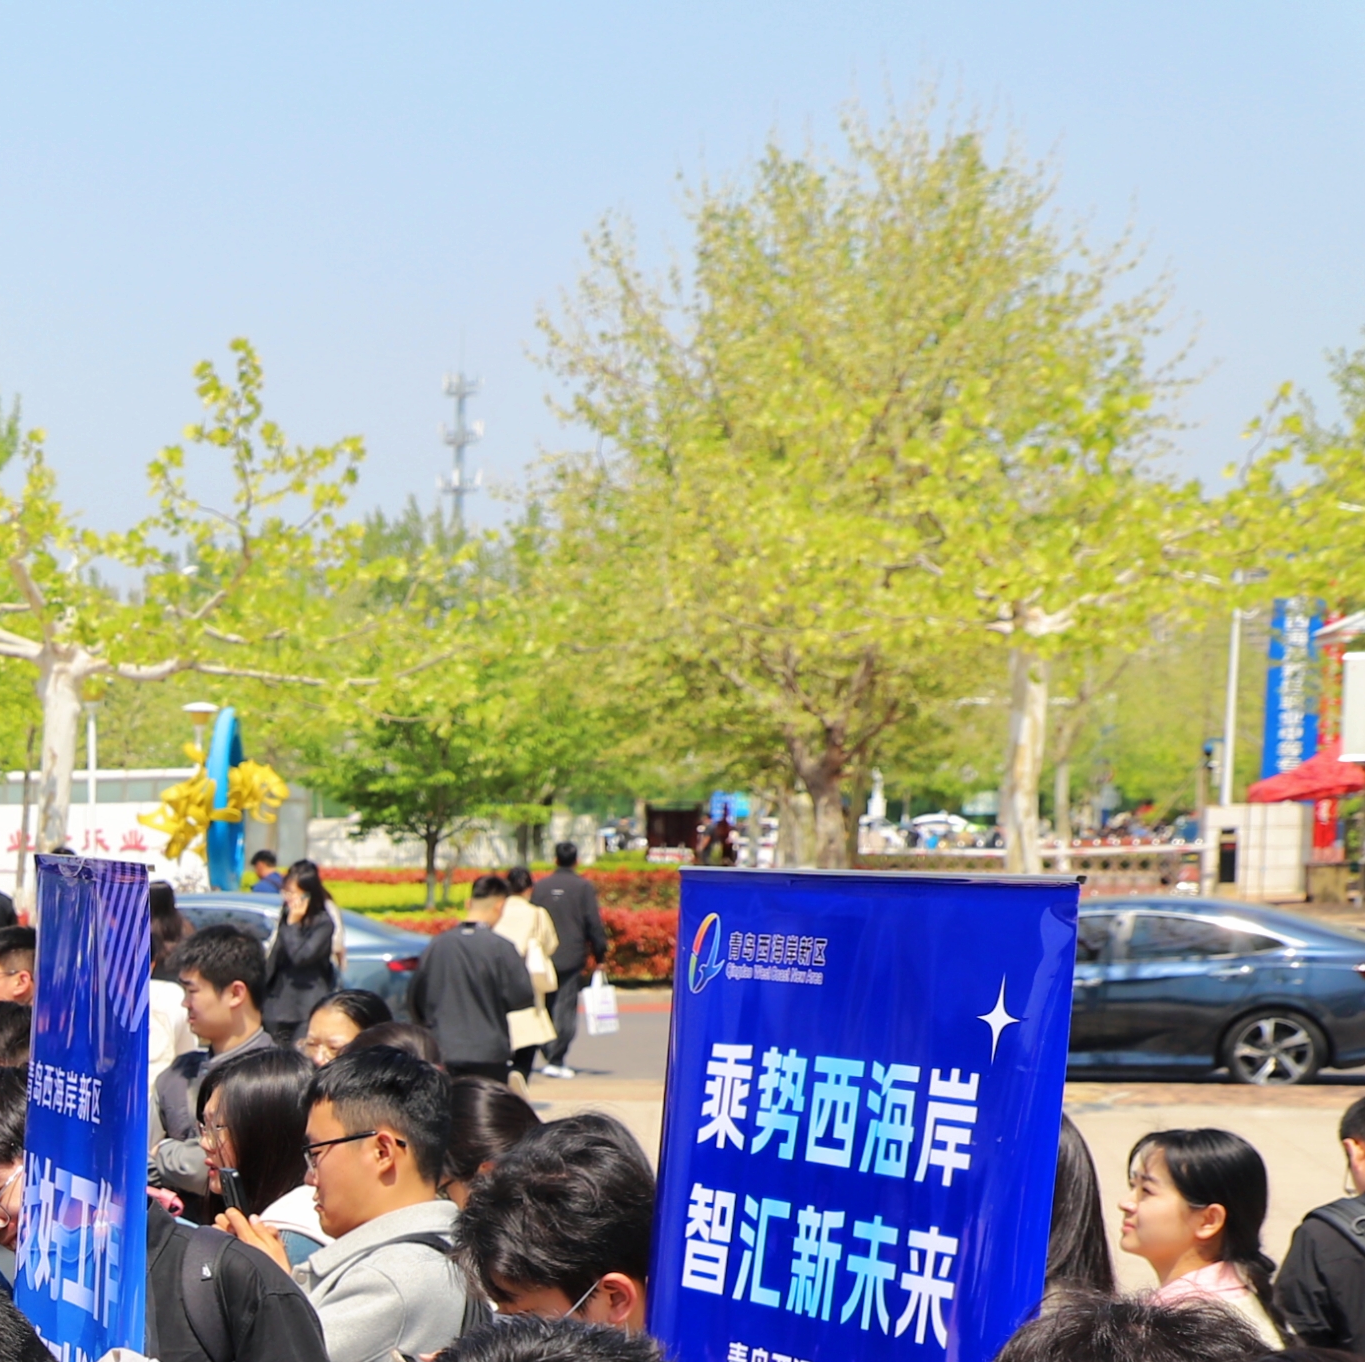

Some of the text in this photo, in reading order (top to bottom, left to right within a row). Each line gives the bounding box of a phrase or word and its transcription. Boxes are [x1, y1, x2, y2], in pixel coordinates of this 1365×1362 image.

[696, 1042, 980, 1187] 乘势西海岸
[681, 1181, 959, 1350] 智汇新未来
